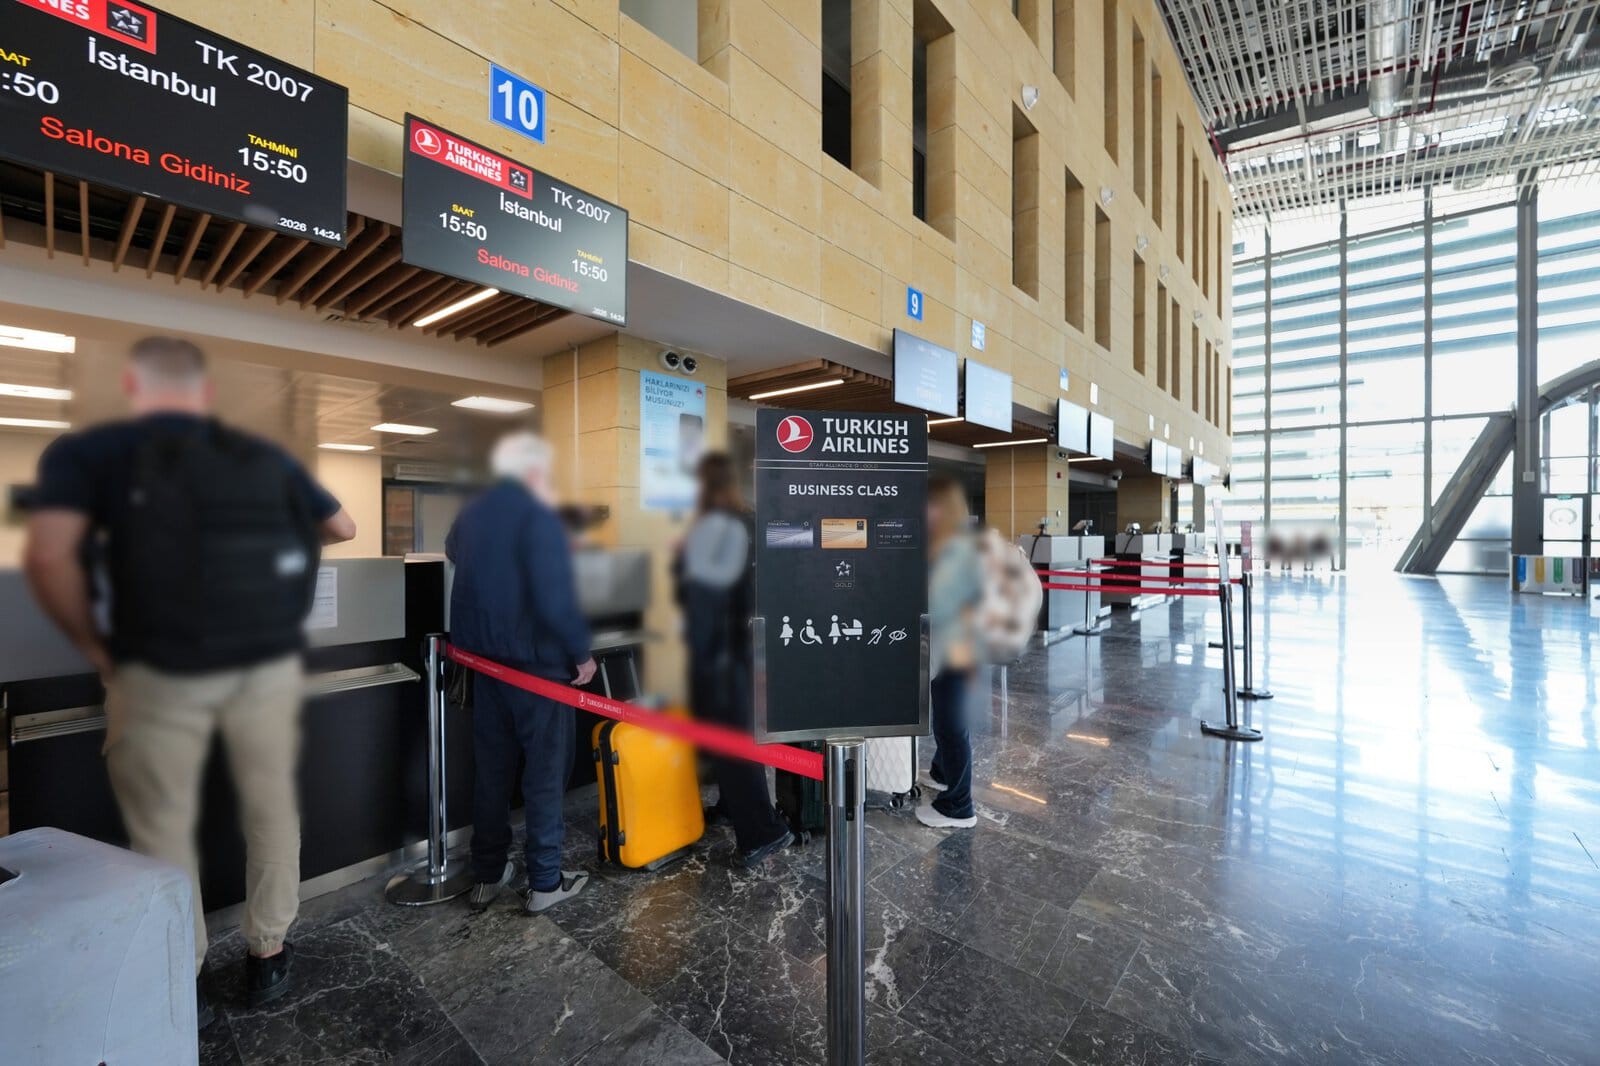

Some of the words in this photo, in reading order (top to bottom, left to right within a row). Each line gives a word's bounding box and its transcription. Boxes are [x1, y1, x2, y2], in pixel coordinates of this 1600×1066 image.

[88, 36, 216, 107] İstanbul
[195, 40, 239, 77] TK
[247, 63, 313, 102] 2007
[497, 80, 538, 131] 10
[40, 116, 150, 166] Salona
[159, 153, 250, 194] Gidiniz
[248, 133, 298, 158] TAHMİNİ
[446, 139, 502, 171] TURKISH
[238, 147, 308, 183] 15:50
[445, 151, 502, 183] AIRLINES
[452, 204, 475, 218] SAAT
[500, 192, 562, 233] İstanbul
[551, 187, 574, 211] TK
[576, 199, 611, 224] 2007
[313, 227, 341, 241] 14:24
[439, 213, 488, 241] 15:50
[477, 249, 529, 277] Salona
[533, 267, 580, 293] Gidiniz
[572, 259, 608, 282] 15:50
[911, 293, 919, 316] 9
[822, 418, 908, 436] TURKISH
[821, 437, 910, 454] AIRLINES
[788, 484, 854, 496] BUSINESS
[857, 485, 899, 497] CLASS
